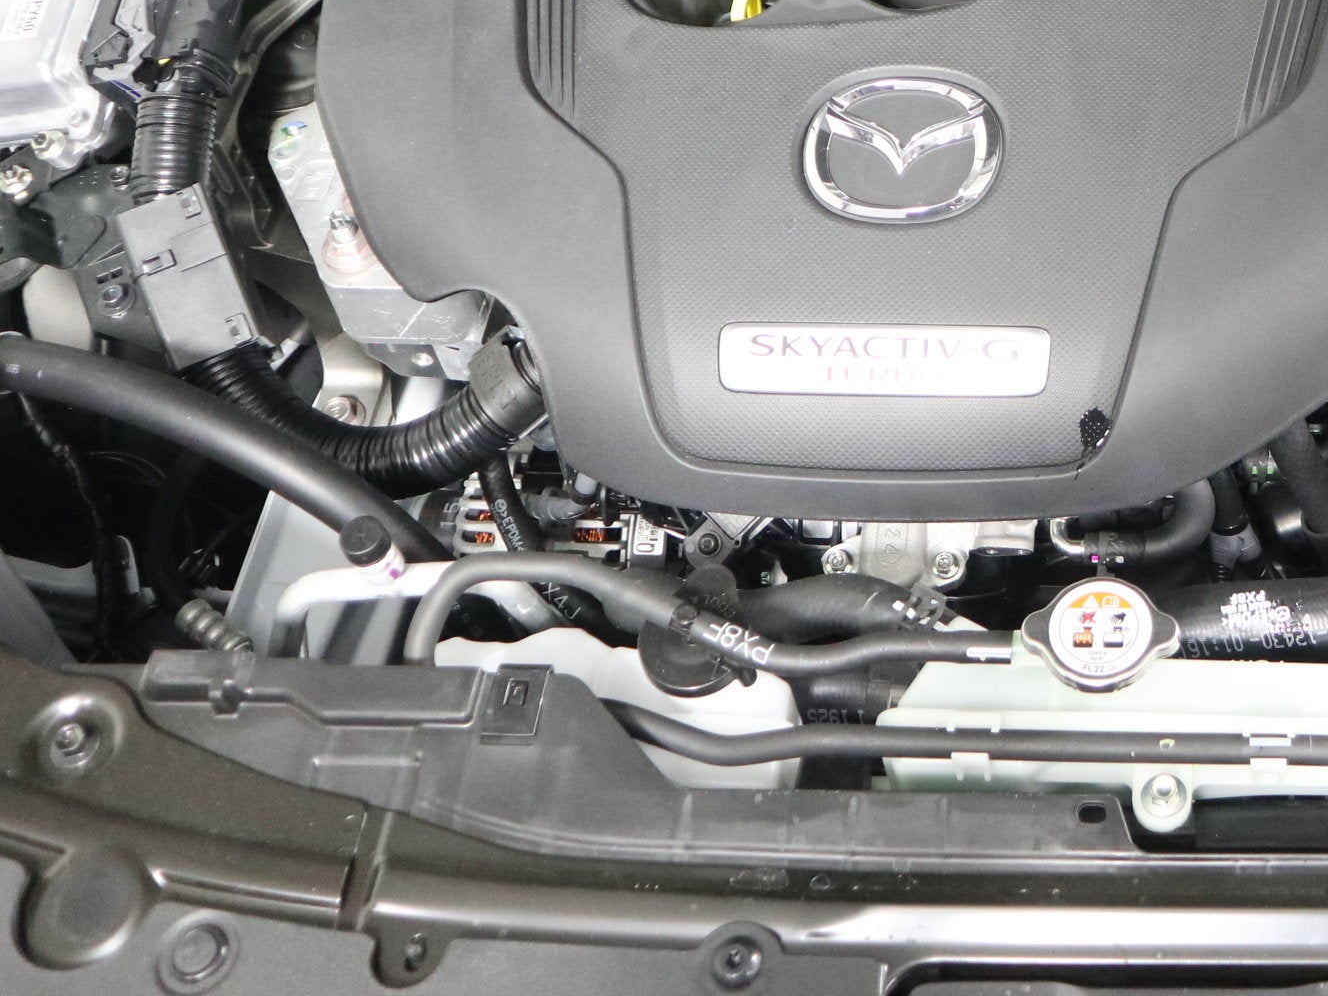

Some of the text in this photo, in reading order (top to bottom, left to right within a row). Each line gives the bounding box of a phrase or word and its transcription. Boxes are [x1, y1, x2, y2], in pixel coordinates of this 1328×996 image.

[748, 332, 1019, 361] SKYACTIV-G
[702, 622, 776, 665] PX8F
[1081, 663, 1106, 673] FL22
